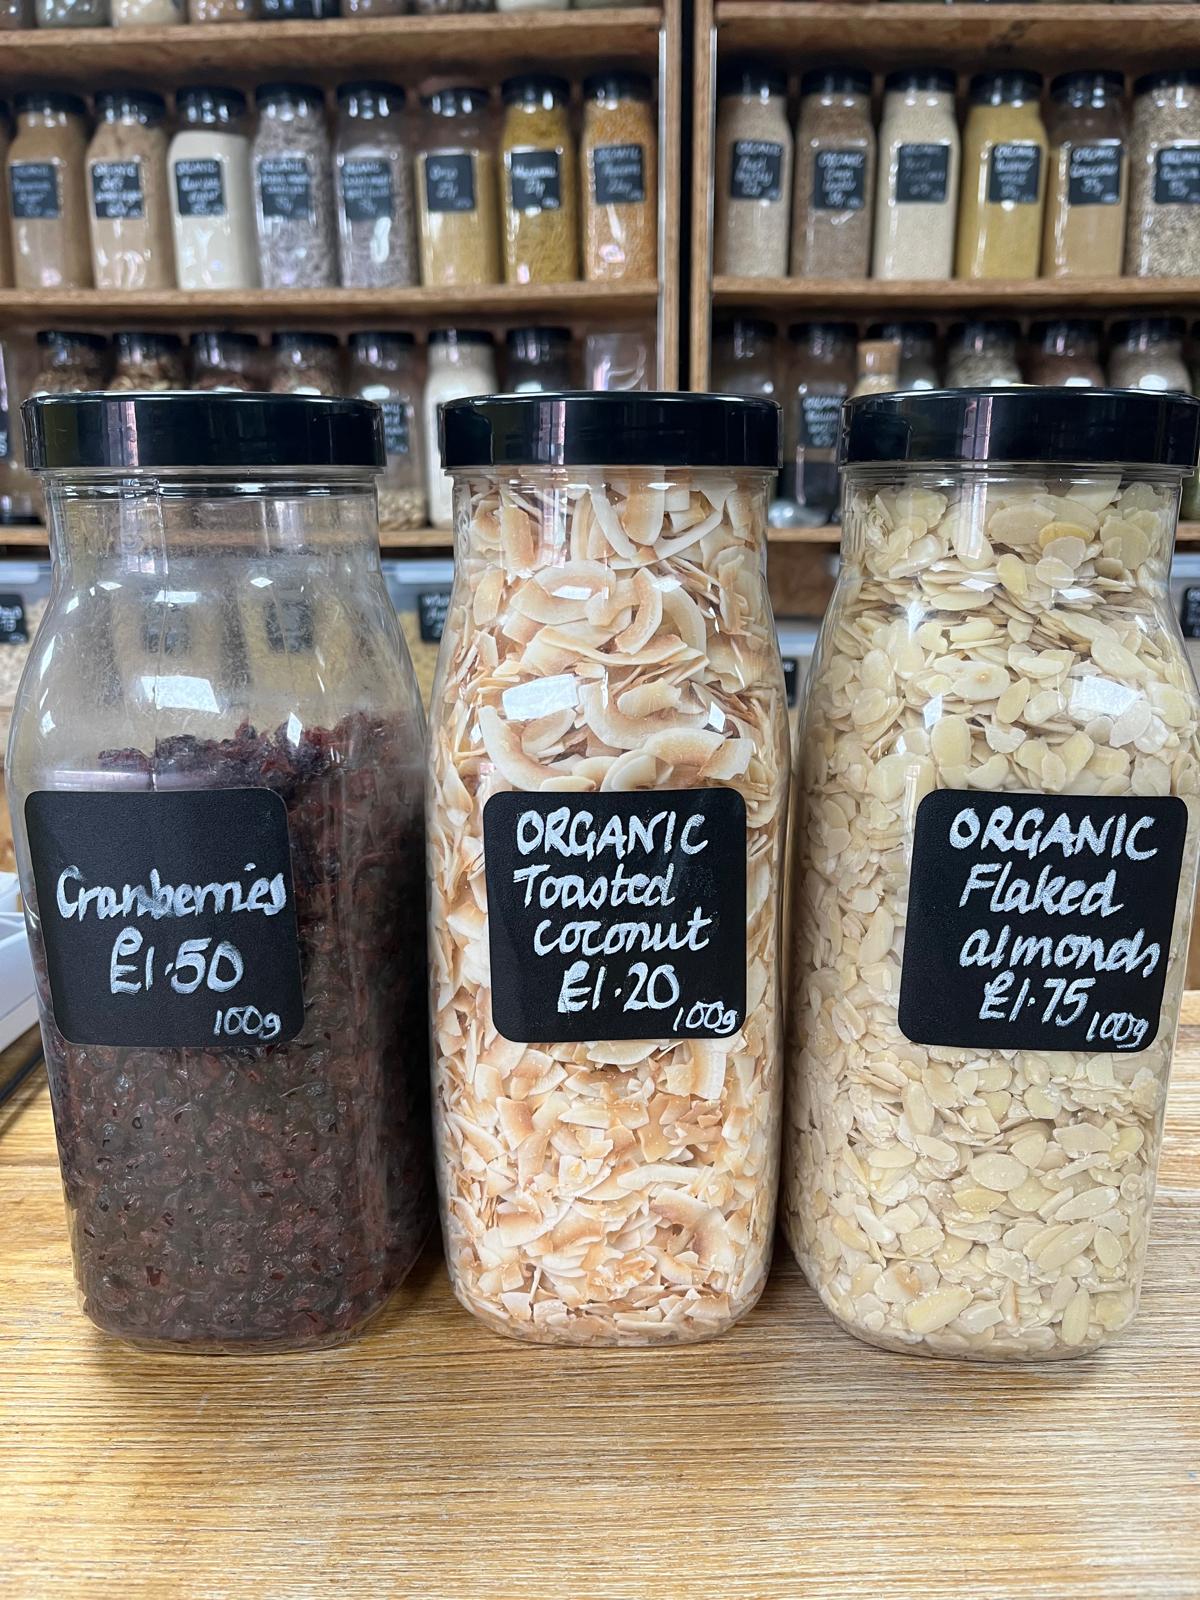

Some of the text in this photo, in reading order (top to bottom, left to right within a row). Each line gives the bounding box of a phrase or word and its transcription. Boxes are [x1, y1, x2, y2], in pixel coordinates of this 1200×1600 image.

[516, 806, 708, 862] ORGANIC
[950, 805, 1158, 860] ORGANIC
[56, 862, 288, 922] Cranberries
[513, 863, 676, 910] Toasted
[959, 861, 1124, 917] Flaked
[959, 925, 1161, 978] almonds
[213, 1005, 281, 1039] 100g
[672, 1001, 738, 1033] 100g
[1086, 1011, 1149, 1048] 100g
